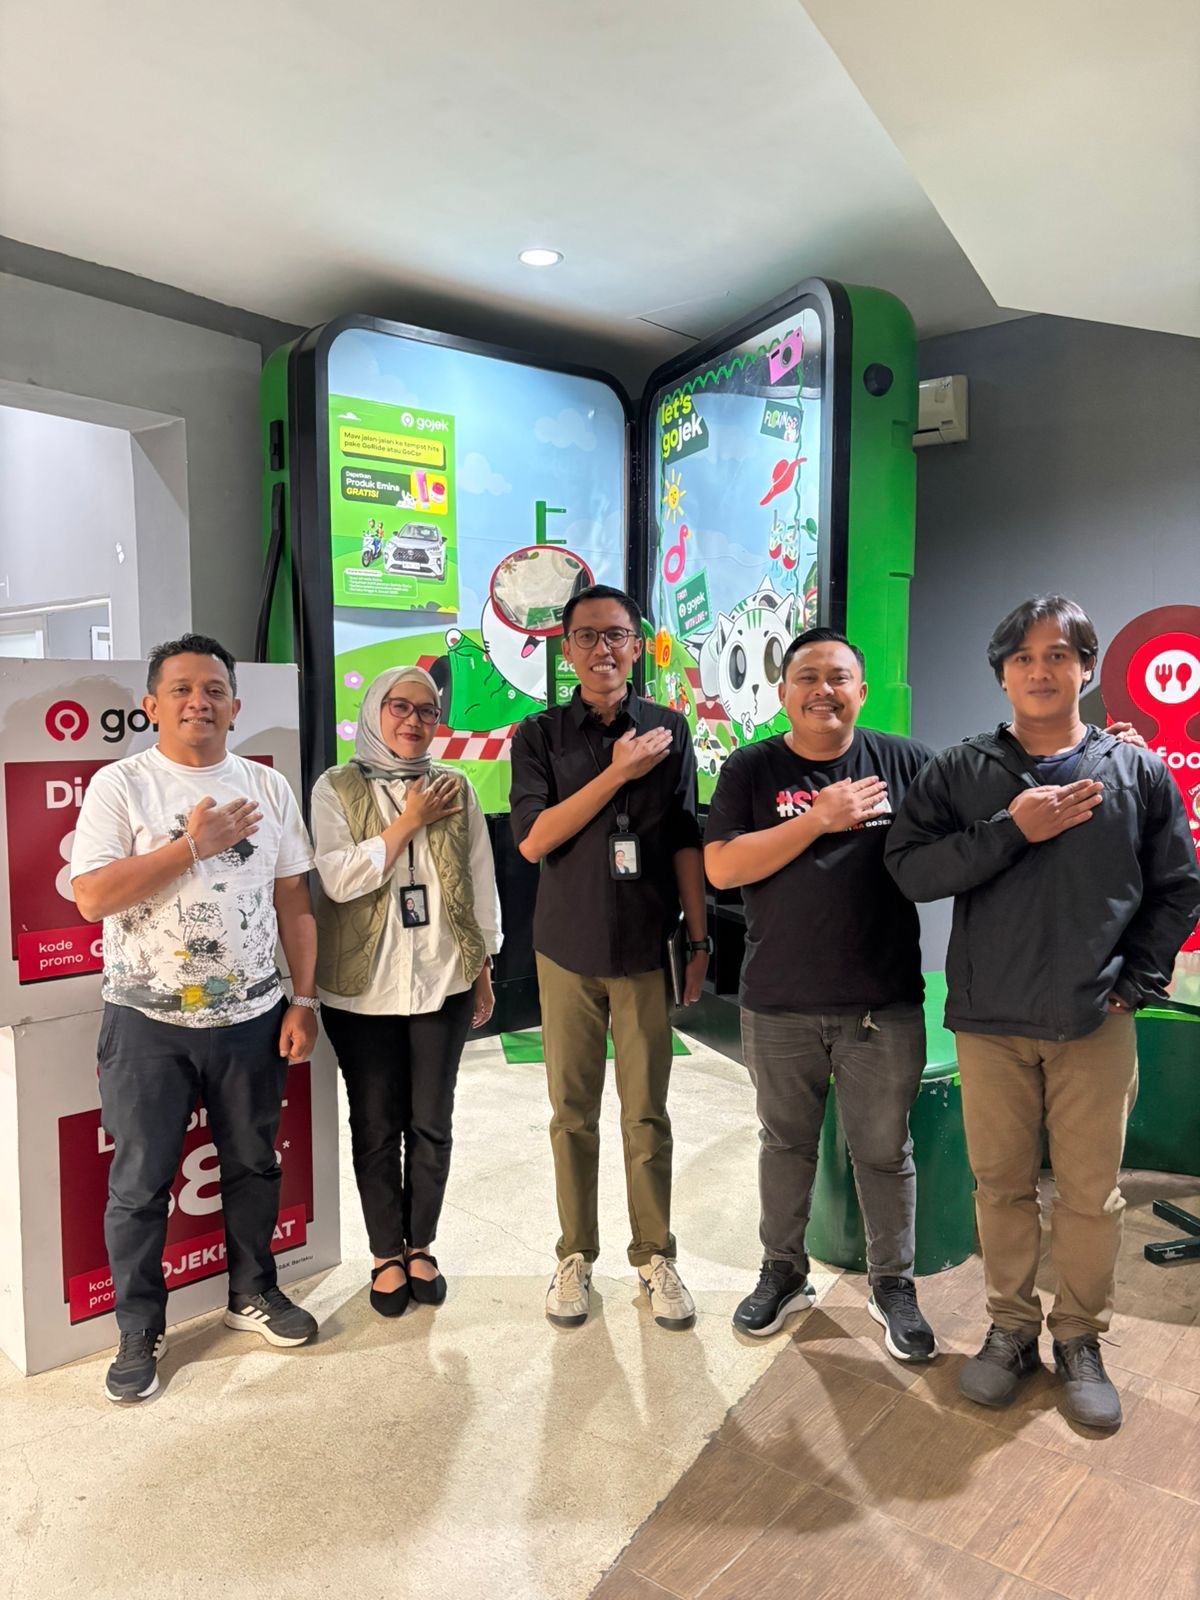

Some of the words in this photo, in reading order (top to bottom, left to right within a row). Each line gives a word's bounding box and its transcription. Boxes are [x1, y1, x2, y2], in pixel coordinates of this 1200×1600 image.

[661, 394, 692, 426] let's
[416, 416, 449, 432] gojek
[662, 413, 703, 459] gojek
[346, 477, 376, 489] Produk
[376, 481, 401, 492] Emina
[346, 486, 380, 498] GRATIS!
[686, 591, 706, 615] gojek
[38, 940, 73, 954] kode
[39, 954, 84, 971] promo
